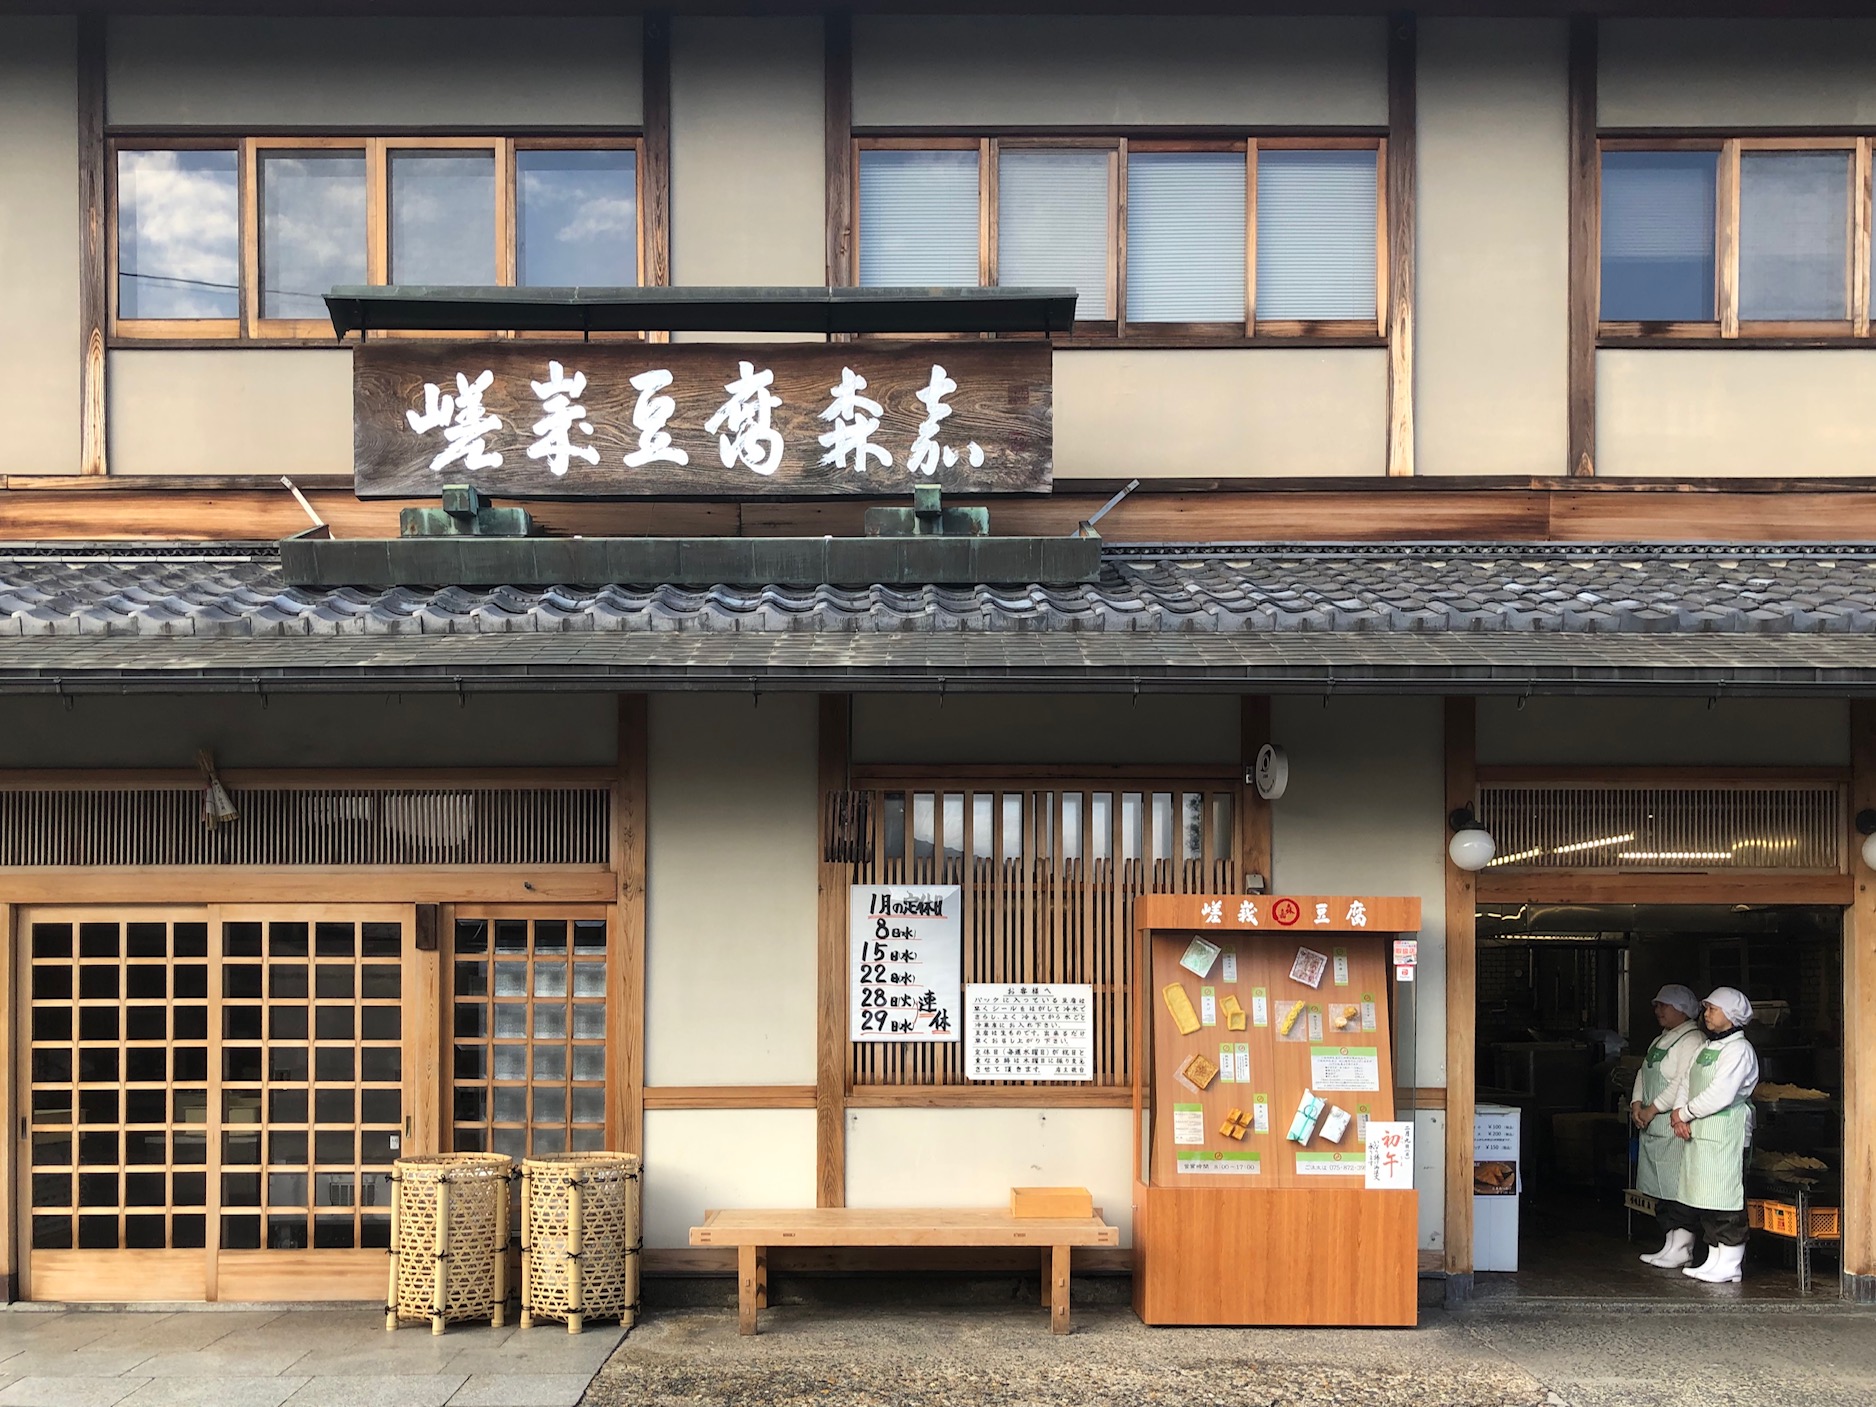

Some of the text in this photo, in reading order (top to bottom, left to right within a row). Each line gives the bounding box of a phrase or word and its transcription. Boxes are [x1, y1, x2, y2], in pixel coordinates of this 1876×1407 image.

[1314, 901, 1367, 926] 豆腐
[1008, 986, 1052, 995] お客様へ
[1381, 1130, 1401, 1178] 初午
